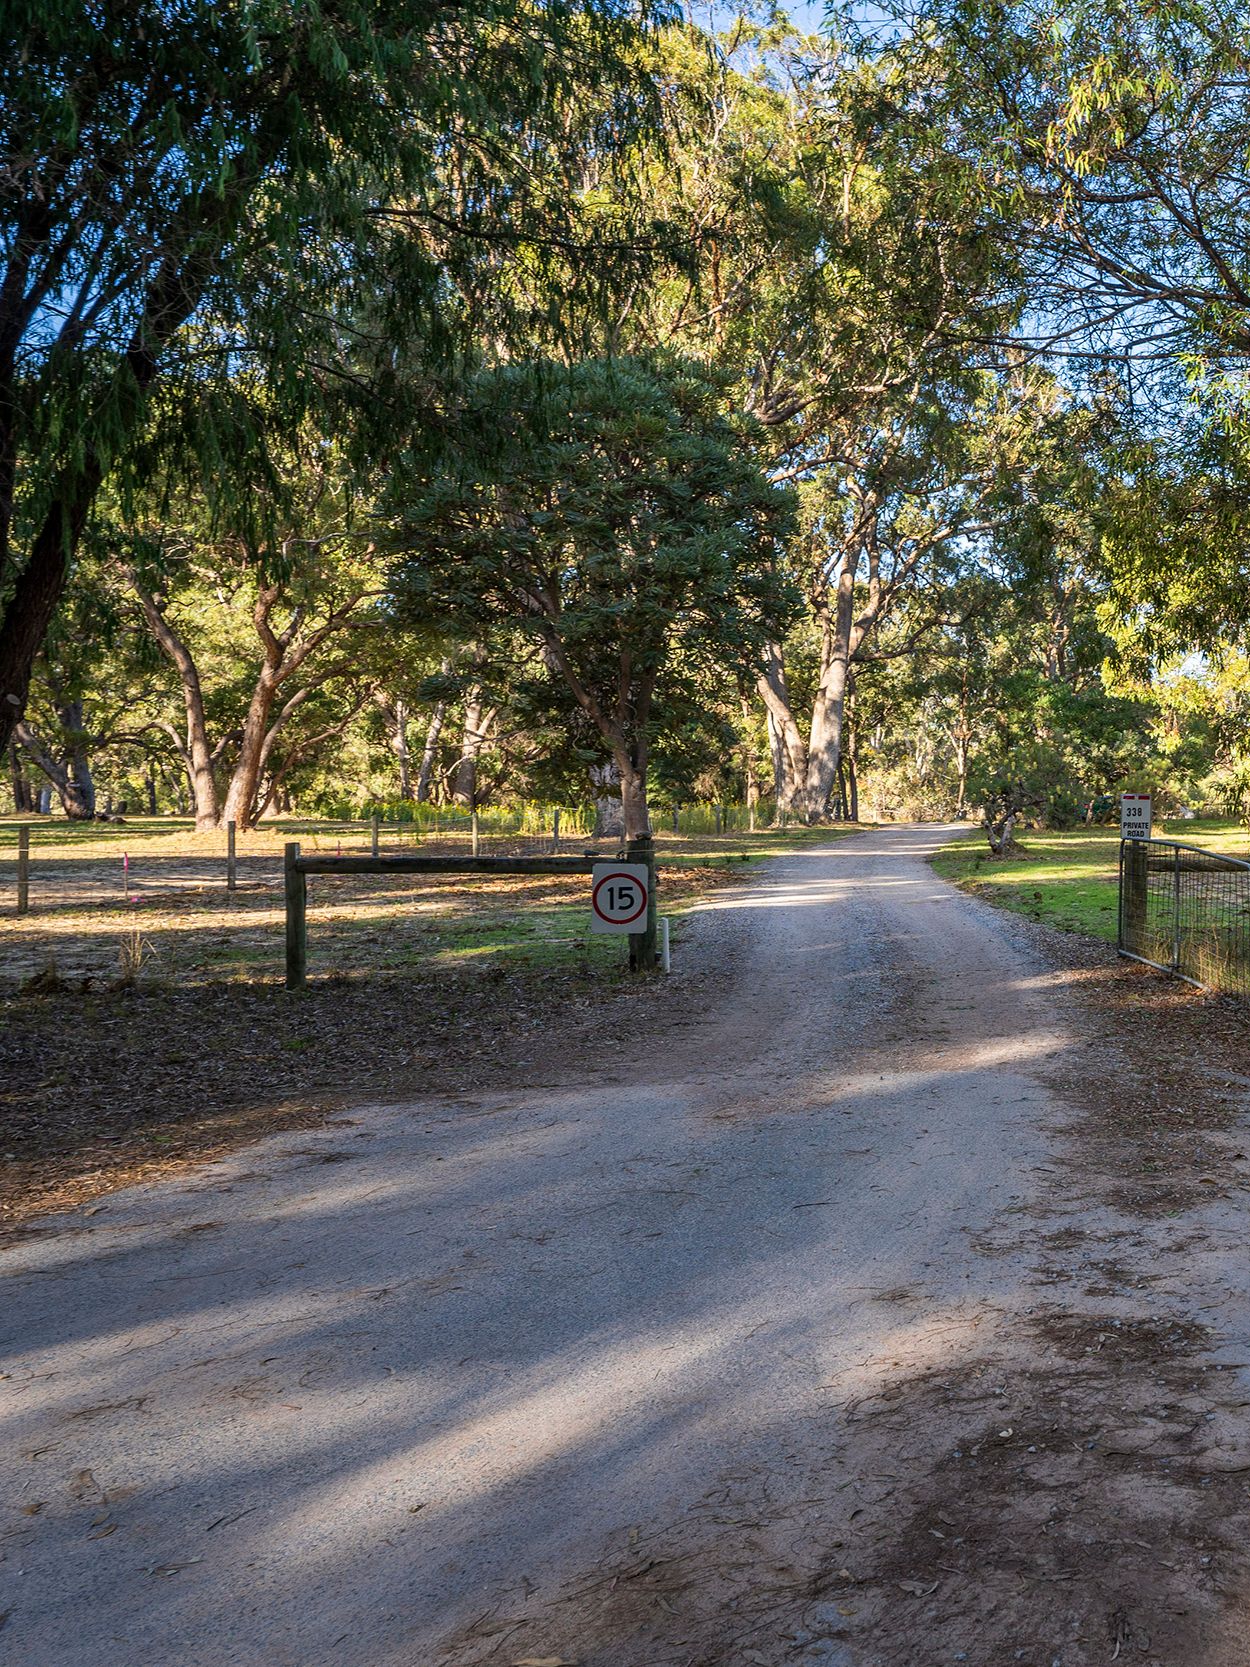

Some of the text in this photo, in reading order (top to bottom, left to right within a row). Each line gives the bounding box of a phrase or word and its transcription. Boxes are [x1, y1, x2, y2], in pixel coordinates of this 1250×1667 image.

[1126, 808, 1143, 817] 338
[1122, 821, 1149, 830] PRIVATE
[1126, 830, 1145, 838] ROAD
[607, 886, 635, 911] 15
